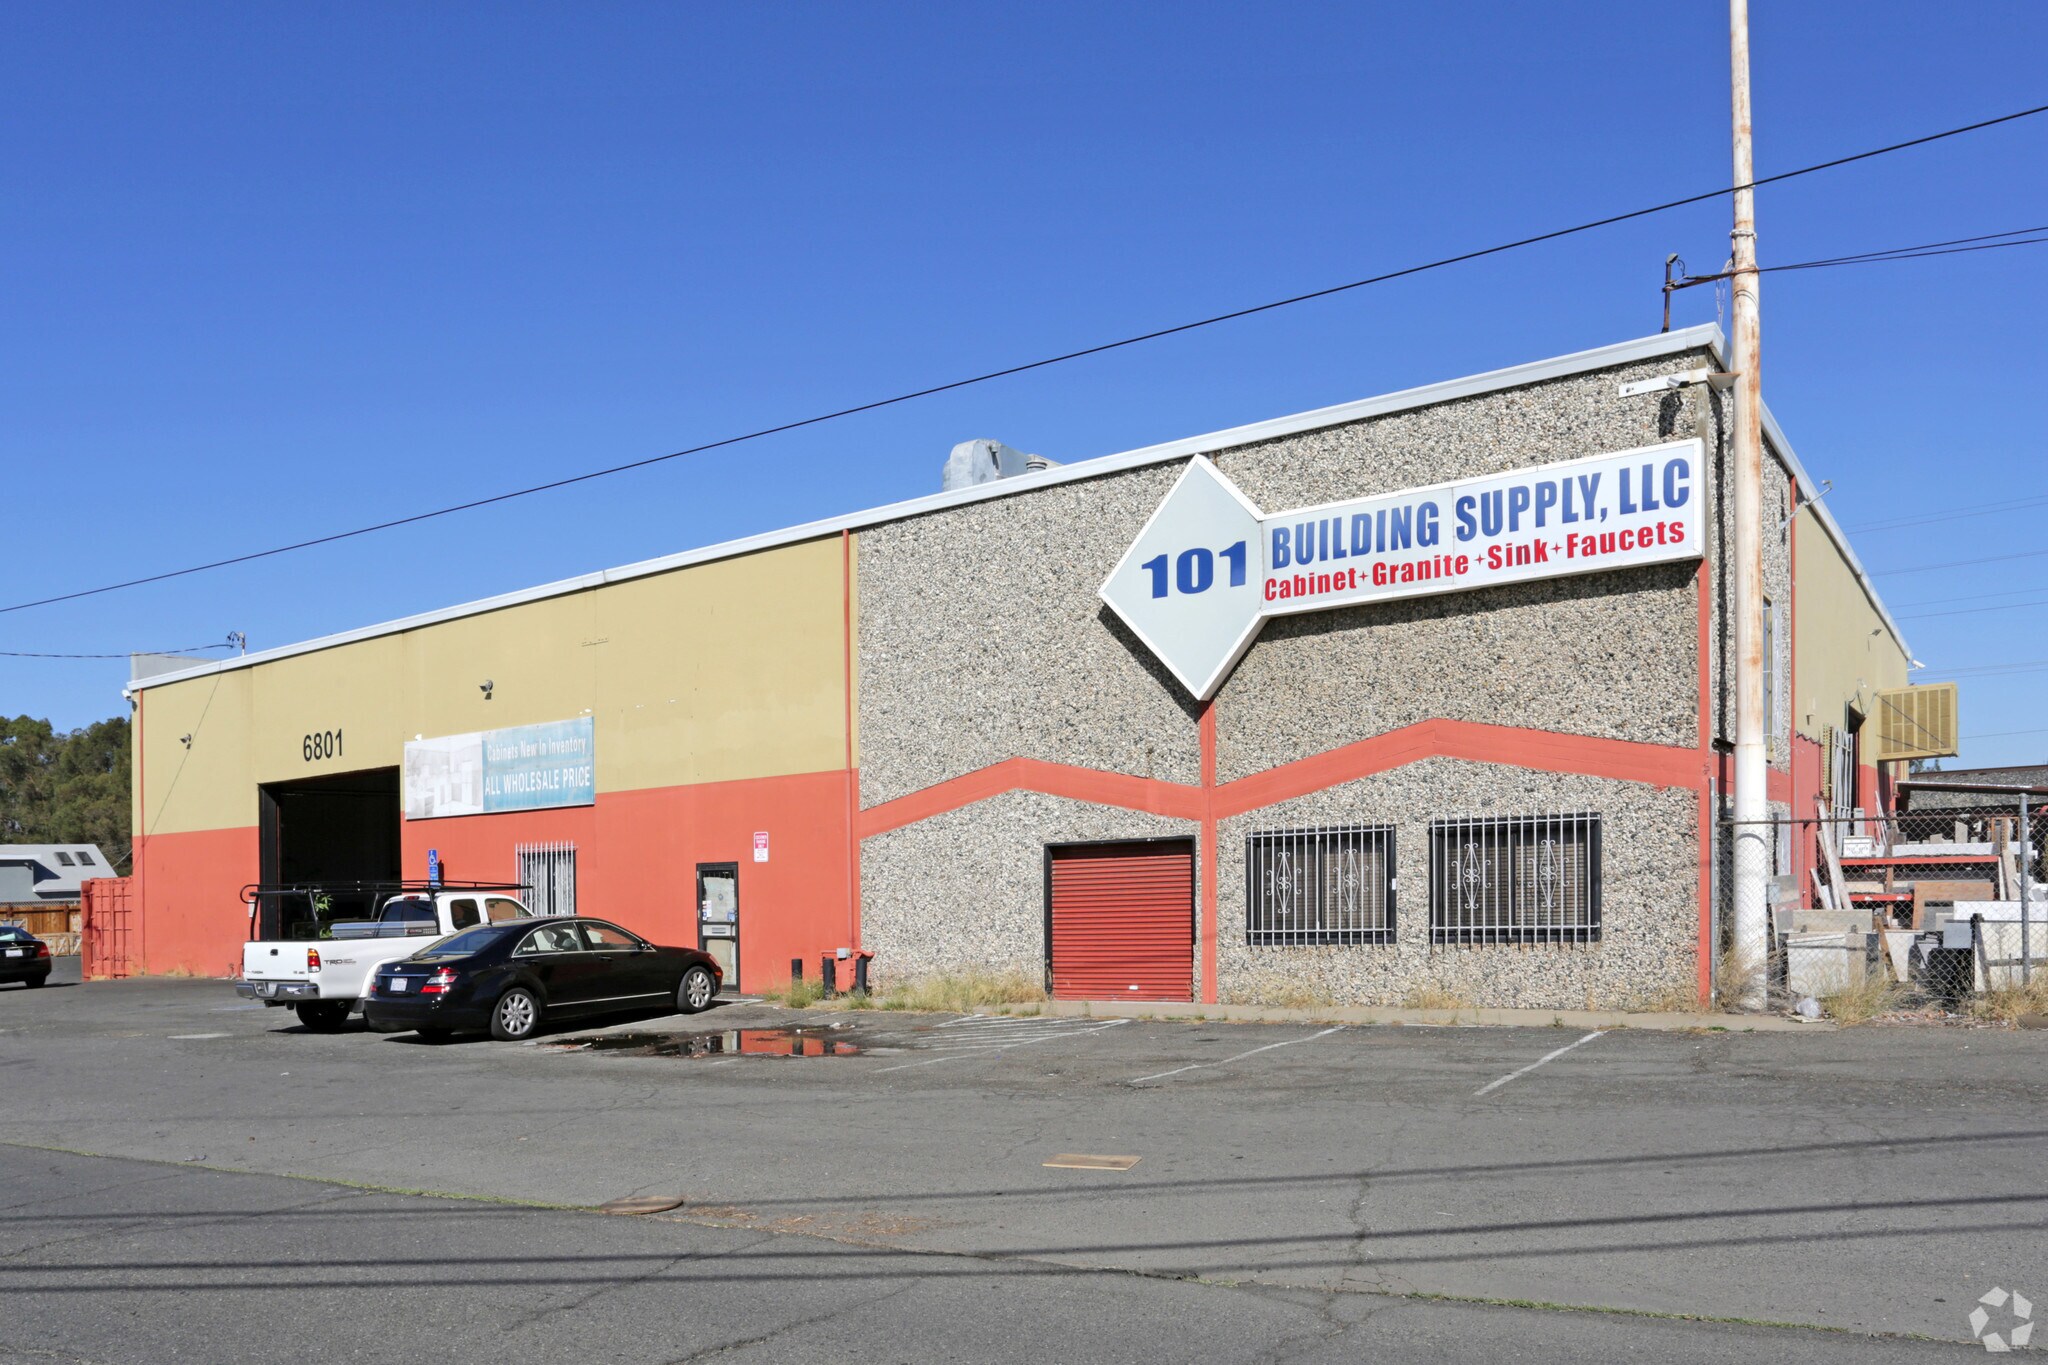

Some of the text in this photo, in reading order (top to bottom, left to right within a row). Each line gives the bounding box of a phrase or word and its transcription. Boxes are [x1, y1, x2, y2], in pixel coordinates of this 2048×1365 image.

[1141, 458, 1690, 599] 101 BUILDING SUPPLY, LLC
[1264, 567, 1357, 601] Cabinet
[1487, 539, 1549, 570] Sink
[1566, 521, 1685, 559] Faucets
[303, 728, 343, 762] 6801
[487, 743, 519, 762] Cabinets
[520, 740, 538, 758] New
[548, 736, 587, 755] Inventory
[485, 766, 591, 796] ALL WHOLESALE PRICE
